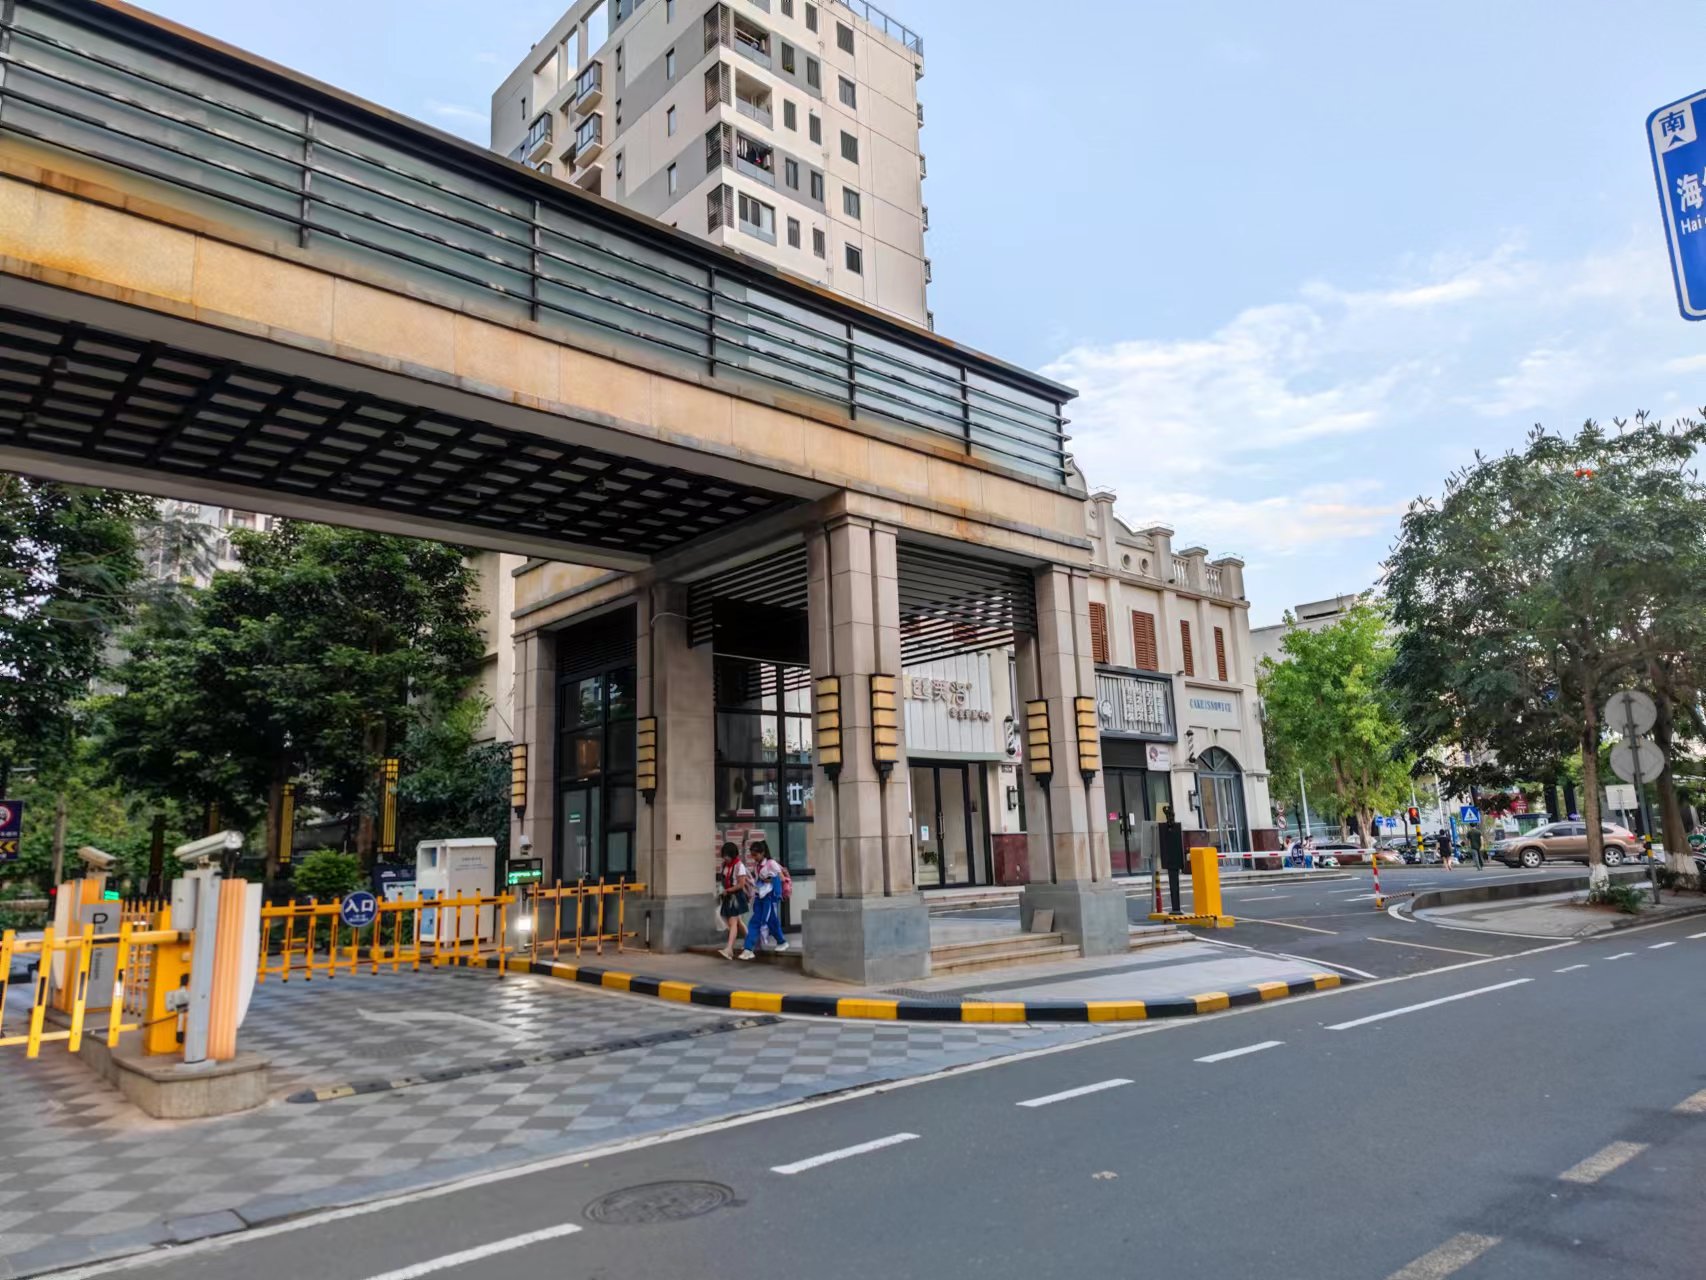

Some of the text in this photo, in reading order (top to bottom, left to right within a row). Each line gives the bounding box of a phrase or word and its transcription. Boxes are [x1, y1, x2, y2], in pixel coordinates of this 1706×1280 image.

[1658, 109, 1685, 137] 南
[1677, 167, 1706, 212] 海
[1680, 214, 1703, 235] Hai
[344, 898, 374, 913] 入口
